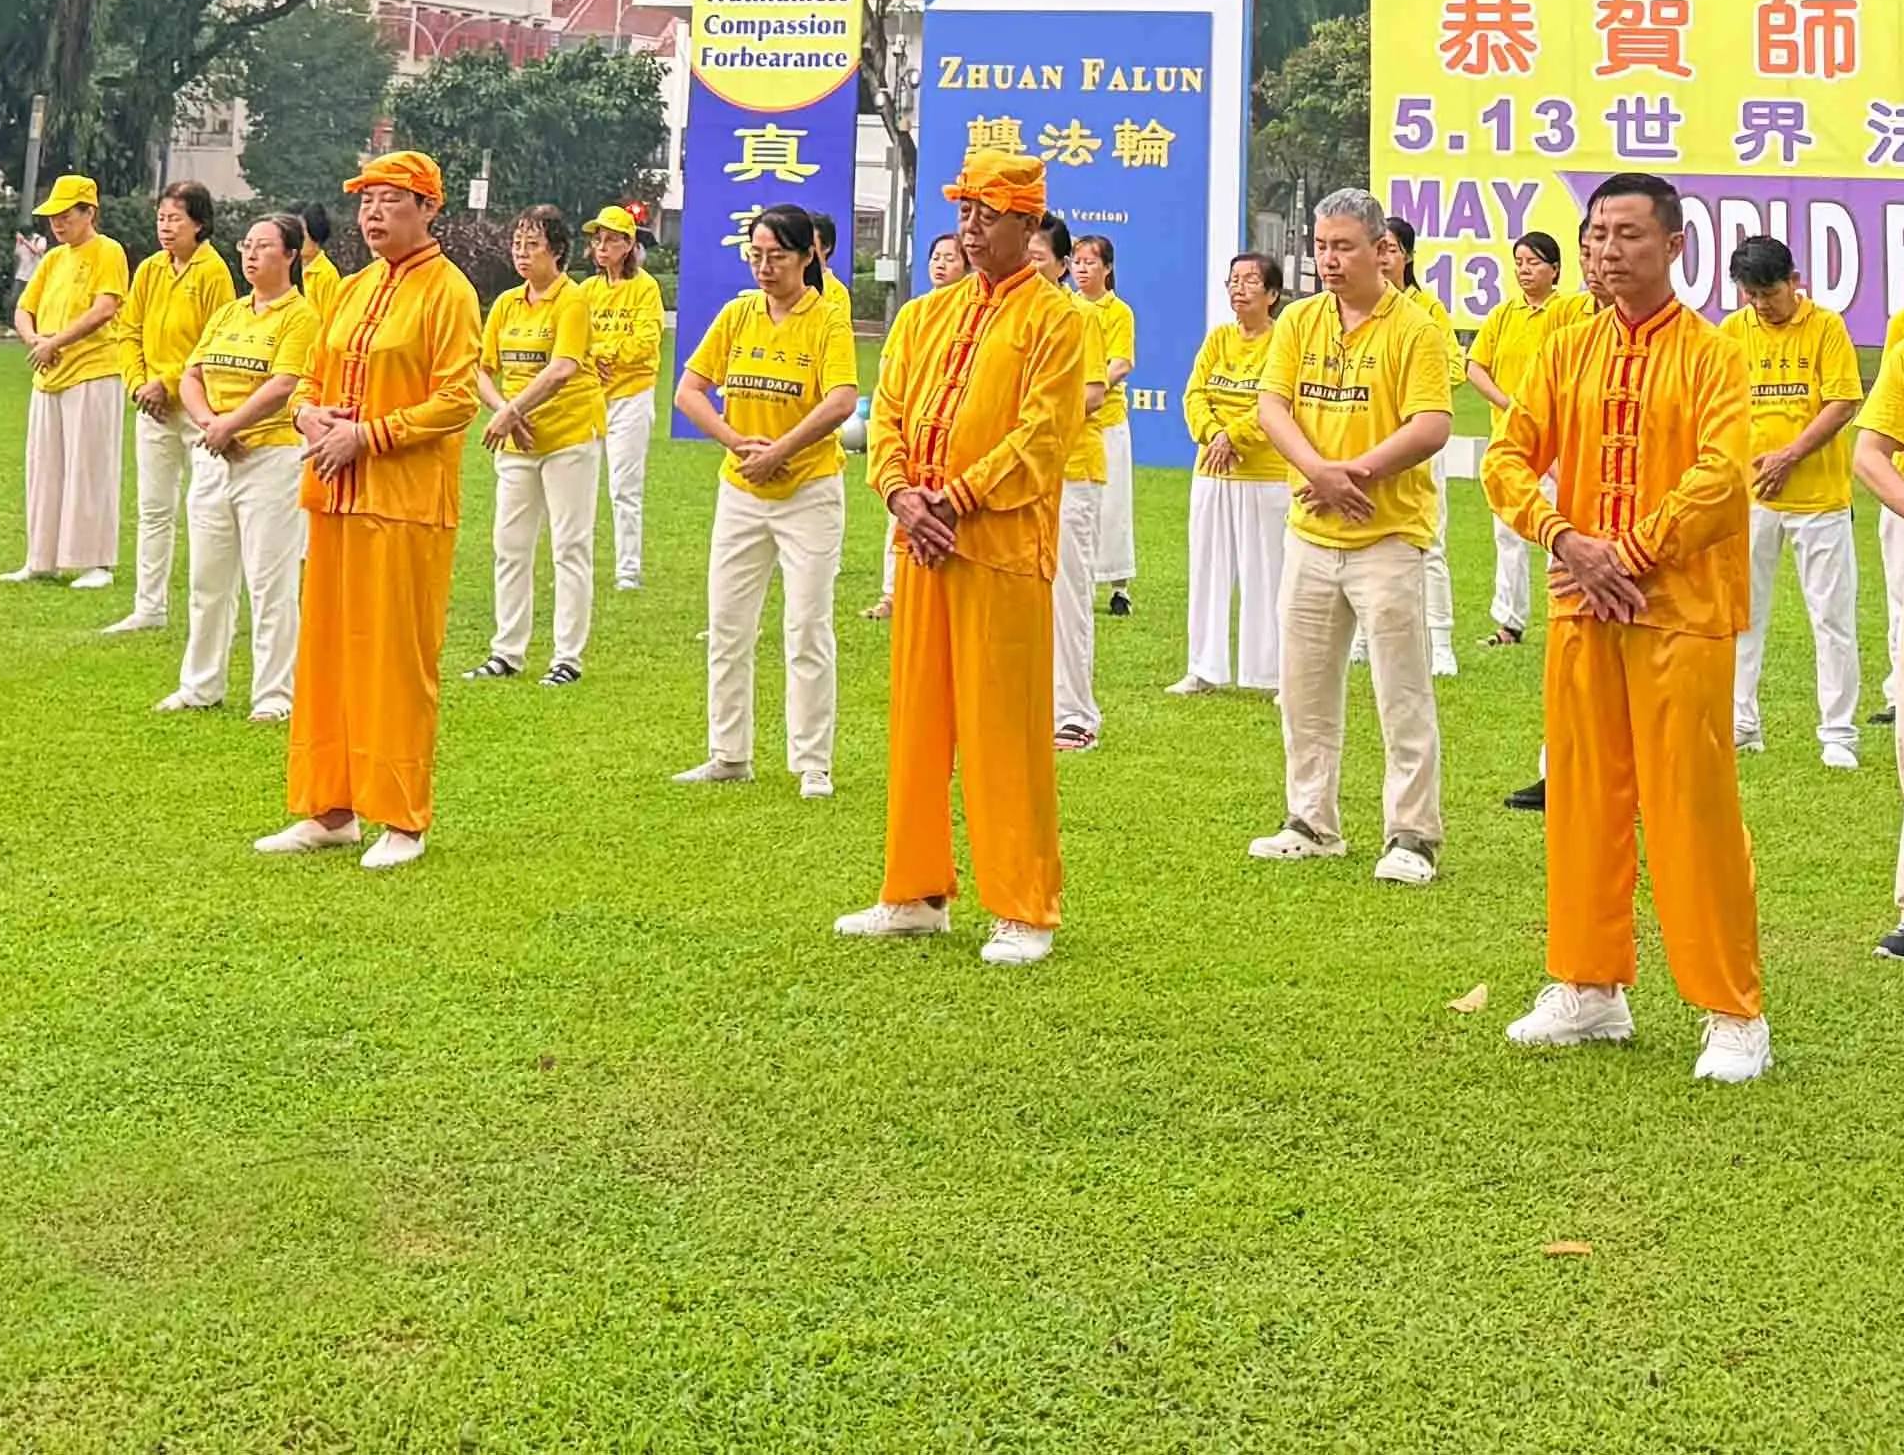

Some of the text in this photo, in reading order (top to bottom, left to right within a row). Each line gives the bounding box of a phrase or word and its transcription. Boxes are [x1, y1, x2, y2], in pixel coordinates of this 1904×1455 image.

[703, 14, 847, 41] Compassion
[700, 45, 848, 70] Forbearance
[1390, 180, 1539, 239] MAY
[1426, 254, 1499, 316] 13
